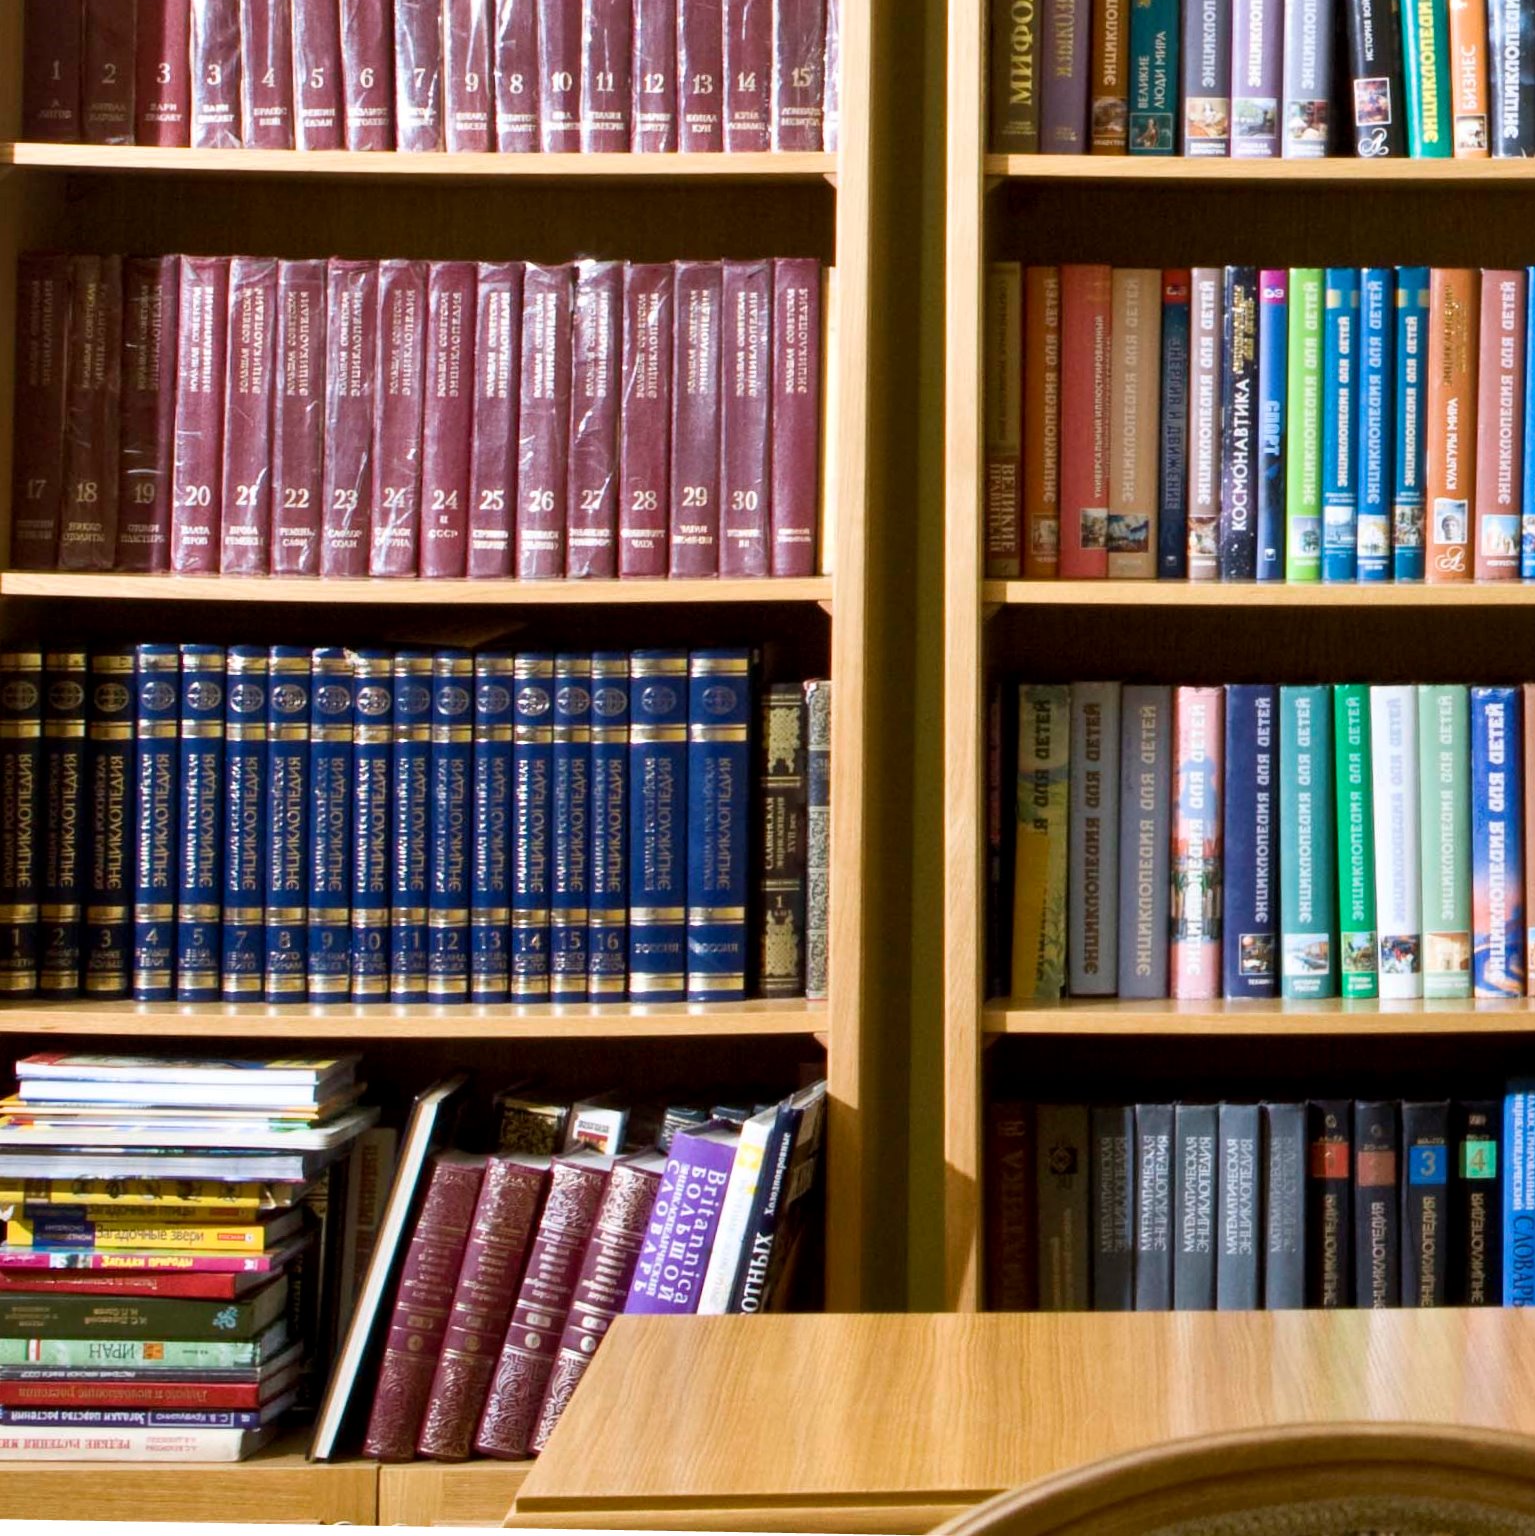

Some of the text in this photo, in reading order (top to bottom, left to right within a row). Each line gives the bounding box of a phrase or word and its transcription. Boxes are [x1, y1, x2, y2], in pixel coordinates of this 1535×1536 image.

[1362, 20, 1374, 62] ИСТОРИЯ
[310, 68, 324, 89] 5
[360, 68, 374, 89] 6
[1137, 55, 1149, 109] ВЕЛИКИЕ
[1154, 31, 1167, 109] ЛЮДИ МИРА
[1462, 44, 1477, 109] БИЗНЕС
[1232, 378, 1251, 531] КОСМОНАВТИКА
[1264, 401, 1280, 456] СПОРТ
[1446, 397, 1458, 490] КУЛЬТУРЫ МИРА
[185, 486, 211, 507] 20
[284, 489, 310, 508] 22
[432, 490, 458, 510] 24
[732, 490, 758, 511] 30
[428, 530, 458, 538] СССР
[1298, 696, 1311, 748] ДЕТЕЙ
[286, 757, 301, 892] ЭНЦИКЛОПЕДИЯ
[1299, 792, 1312, 924] ЭНЦИКЛОПЕДИЯ
[146, 929, 158, 945] 4
[279, 931, 290, 948] 8
[764, 1132, 792, 1216] Холоднокровные
[1421, 1150, 1436, 1177] 3
[1183, 1136, 1198, 1254] МАТЕМАТИЧЕСКАЯ
[1199, 1136, 1212, 1254] ЭНЦИКЛОПЕДИЯ
[95, 1224, 204, 1249] Загадочные звери
[633, 1159, 680, 1293] СЛОВАРЬ
[657, 1165, 705, 1302] БОЛЬШОЙ
[674, 1169, 727, 1305] Britannica
[1421, 1195, 1436, 1308] ЭНЦИКЛОПЕДИЯ
[740, 1232, 774, 1315] ОТНЫХ
[89, 1343, 135, 1359] ИРАН
